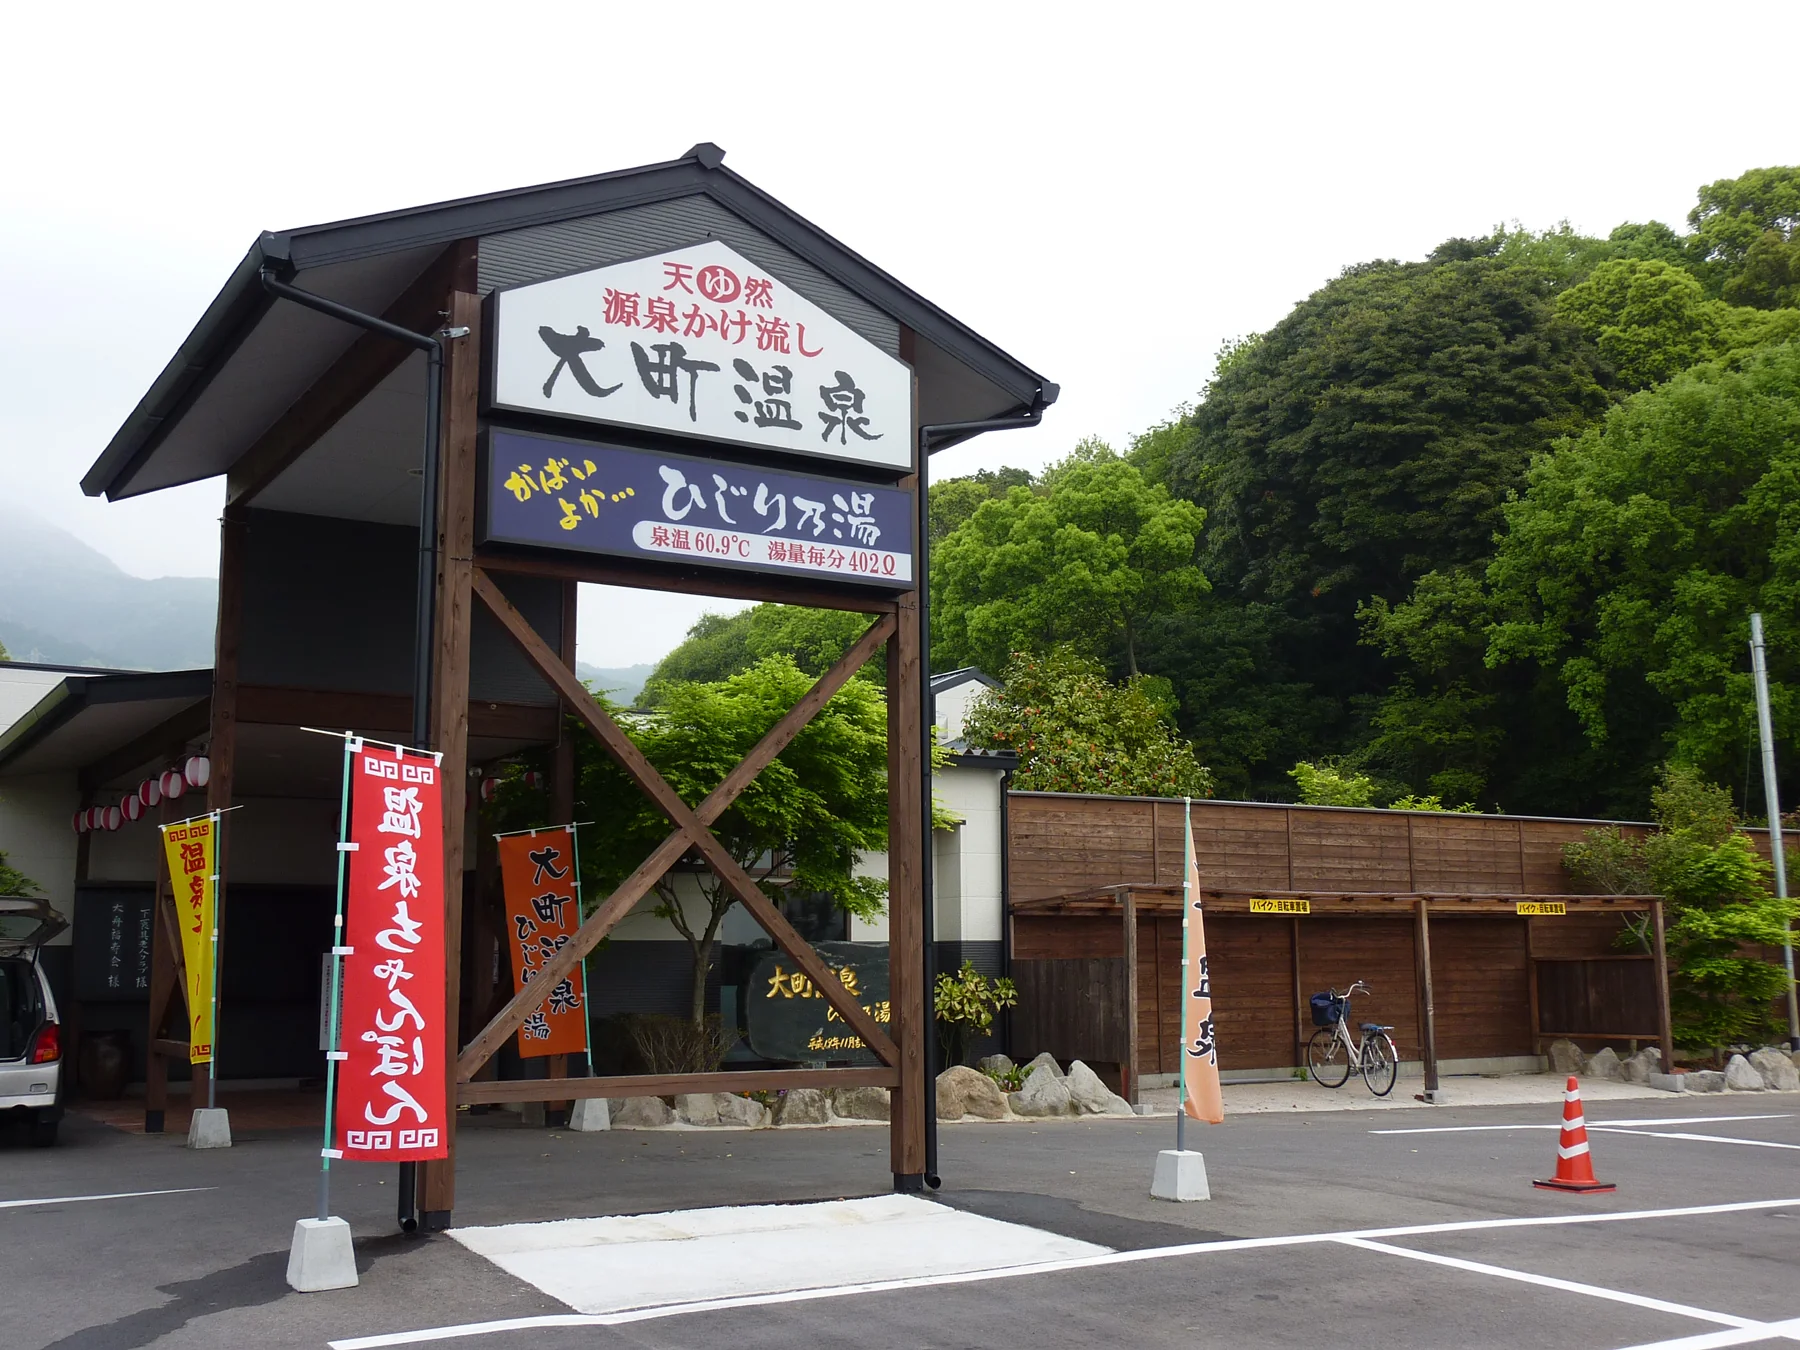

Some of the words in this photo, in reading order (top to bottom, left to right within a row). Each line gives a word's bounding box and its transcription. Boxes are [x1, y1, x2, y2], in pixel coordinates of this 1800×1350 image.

[602, 287, 824, 358] 源泉かけ流し
[538, 325, 883, 445] 大町温泉
[504, 458, 597, 502] がばい
[658, 465, 881, 545] ひじり乃湯
[766, 964, 862, 999] 大町泉
[807, 1036, 867, 1051] 平成19年11月吉
